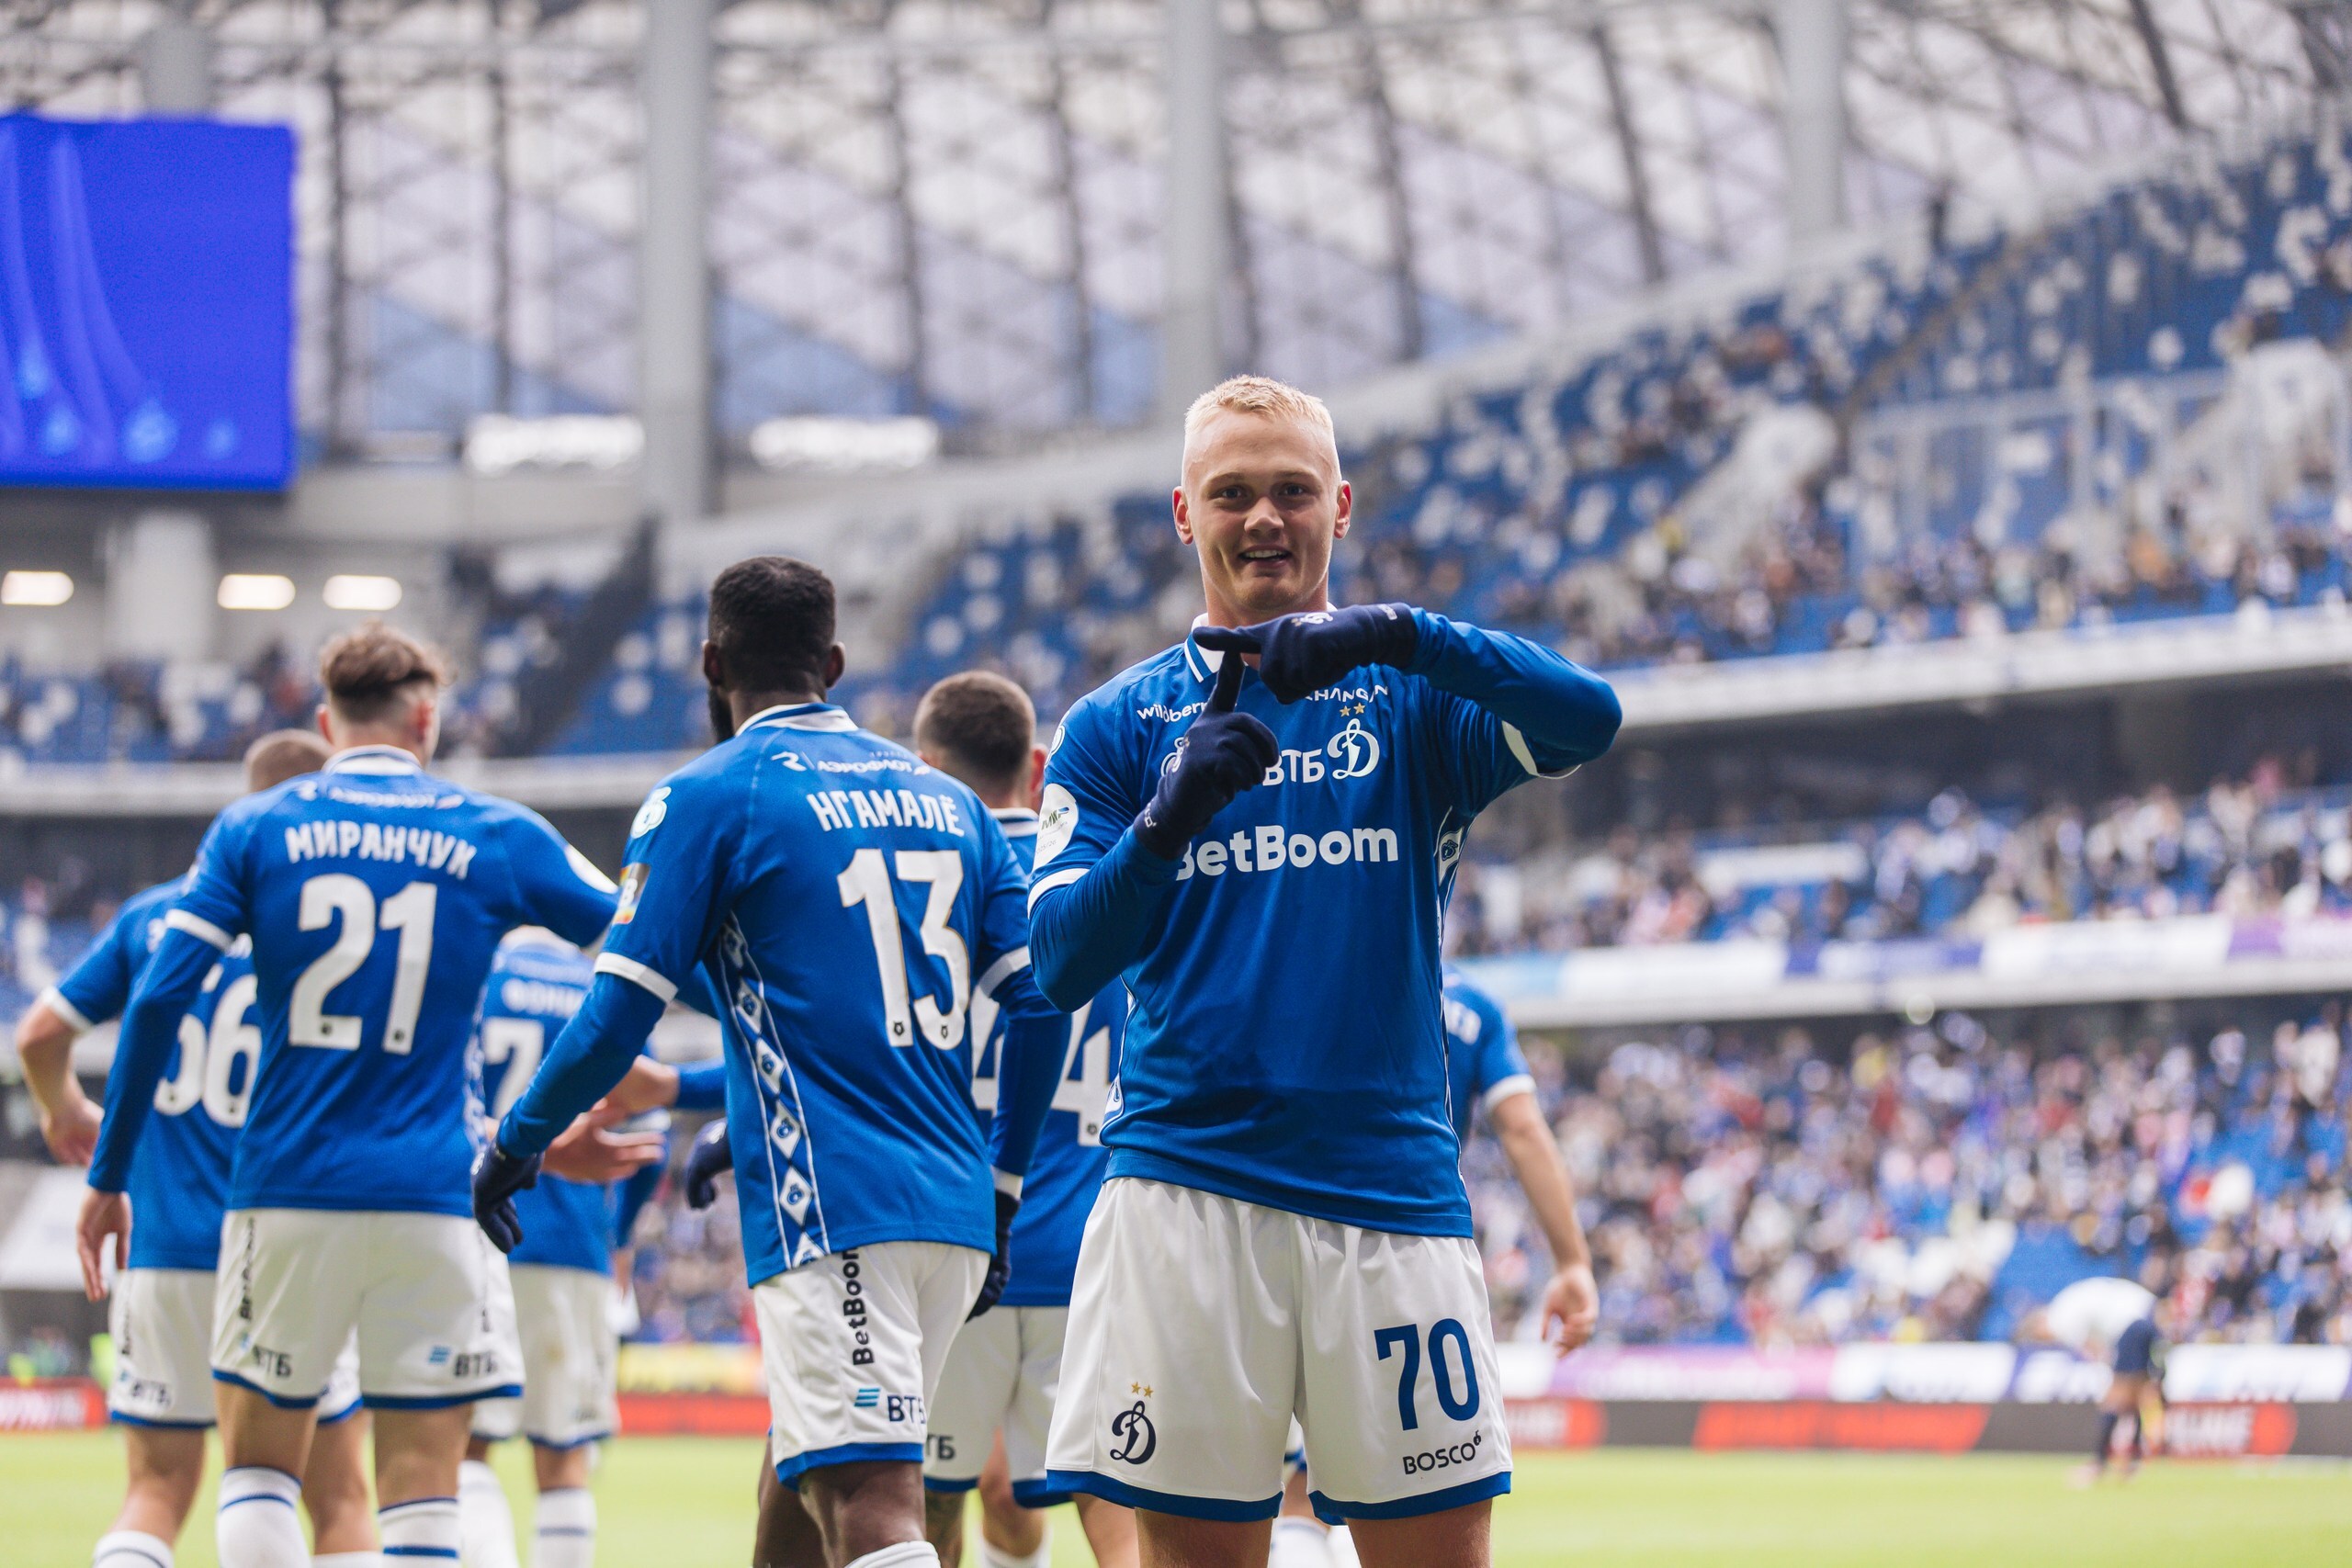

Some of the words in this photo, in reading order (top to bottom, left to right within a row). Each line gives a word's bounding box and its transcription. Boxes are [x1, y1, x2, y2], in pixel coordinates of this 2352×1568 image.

[284, 819, 478, 881] МИРАНЧУК
[806, 789, 965, 837] НГАМАЛЁ
[288, 873, 438, 1055] 21
[837, 849, 971, 1050] 13
[1374, 1318, 1480, 1431] 70
[1402, 1442, 1476, 1475] BOSCO
